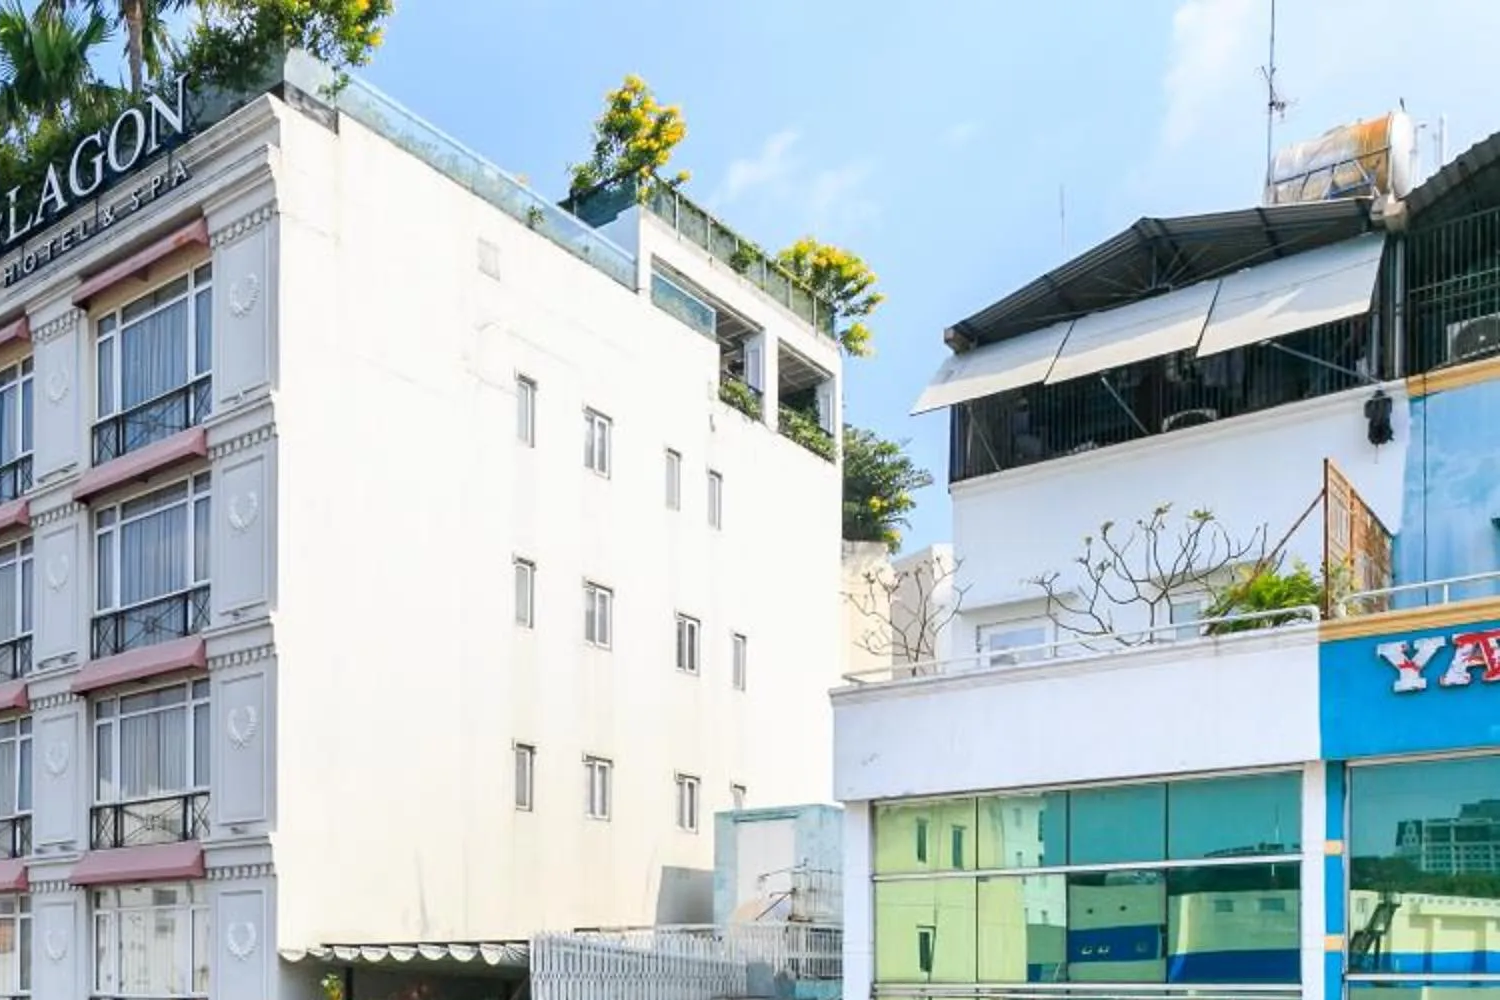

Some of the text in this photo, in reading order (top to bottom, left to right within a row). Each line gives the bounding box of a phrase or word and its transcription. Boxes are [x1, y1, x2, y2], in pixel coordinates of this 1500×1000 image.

[3, 160, 189, 287] HOTEL & SPA
